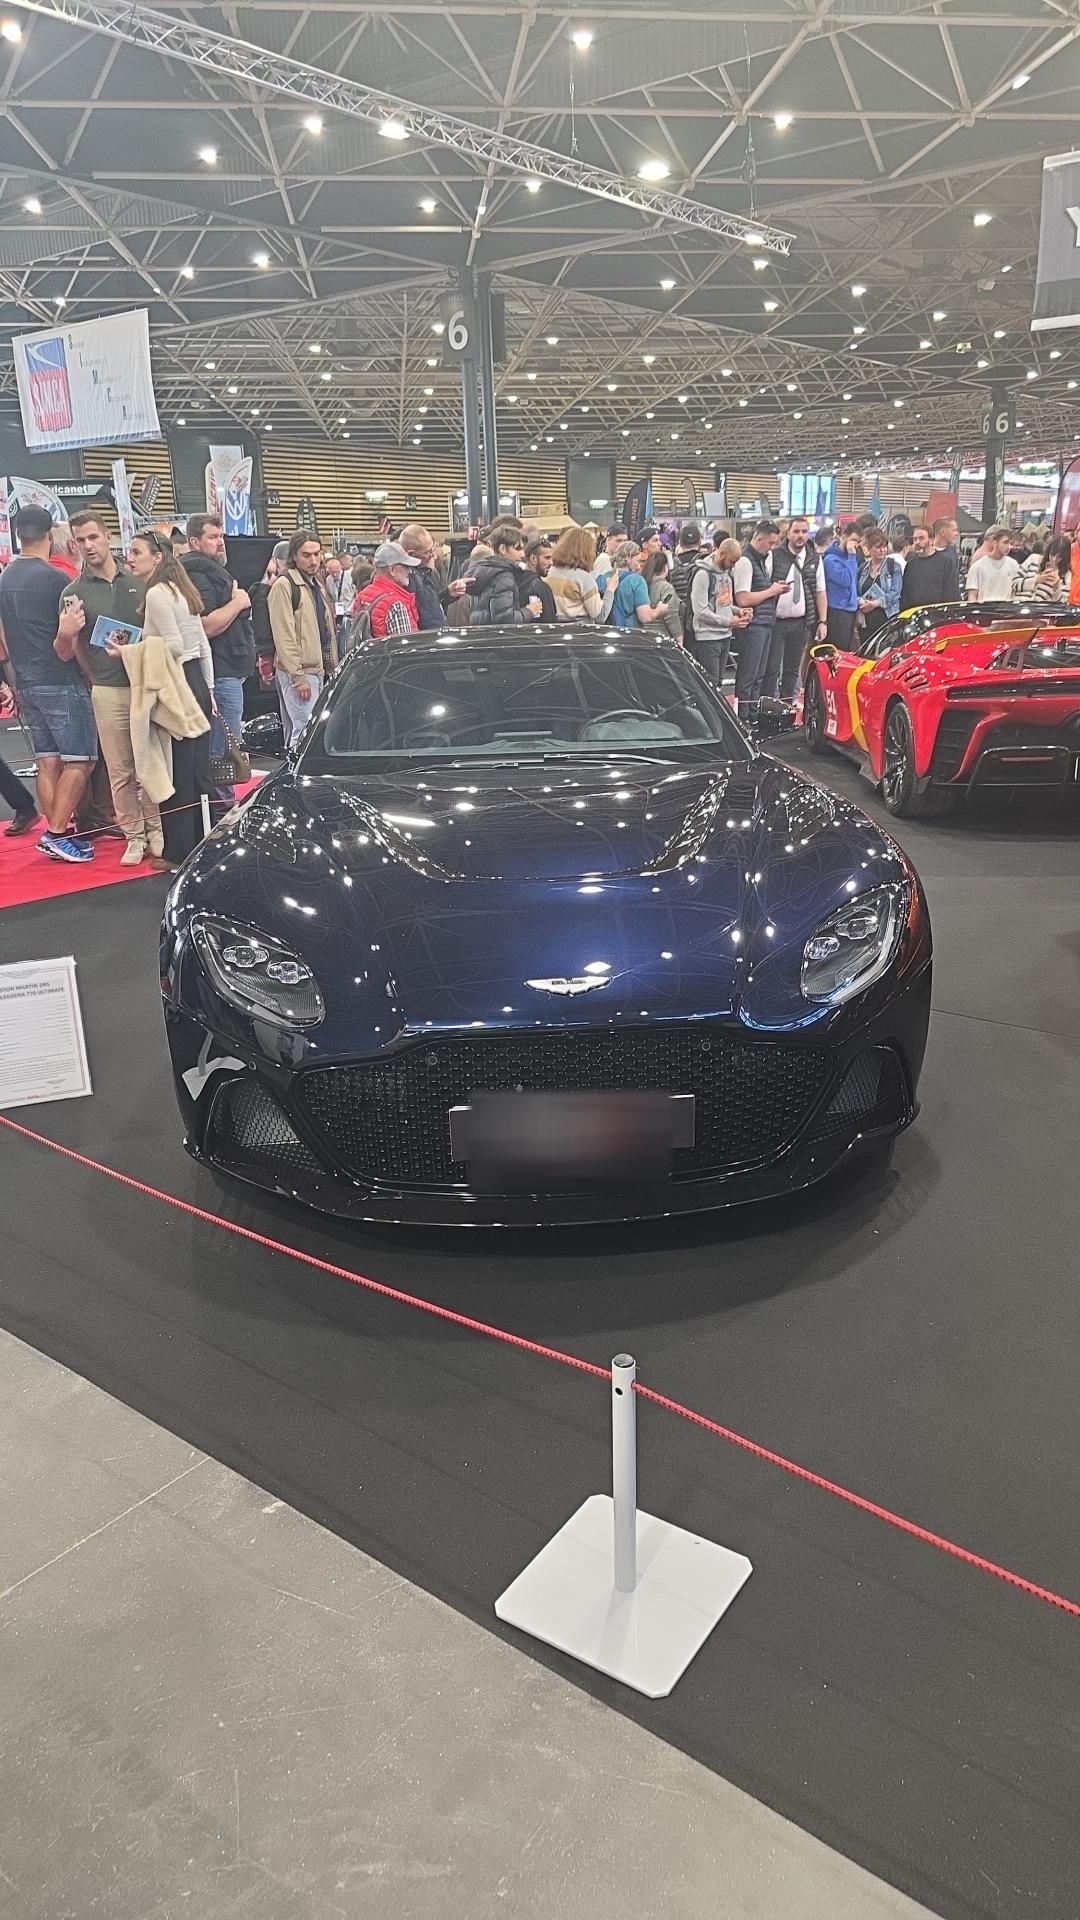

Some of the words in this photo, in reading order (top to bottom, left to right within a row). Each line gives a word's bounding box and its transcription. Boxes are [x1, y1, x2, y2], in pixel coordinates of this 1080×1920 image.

[448, 310, 468, 351] 6
[983, 413, 990, 435] 6
[996, 412, 1009, 434] 6
